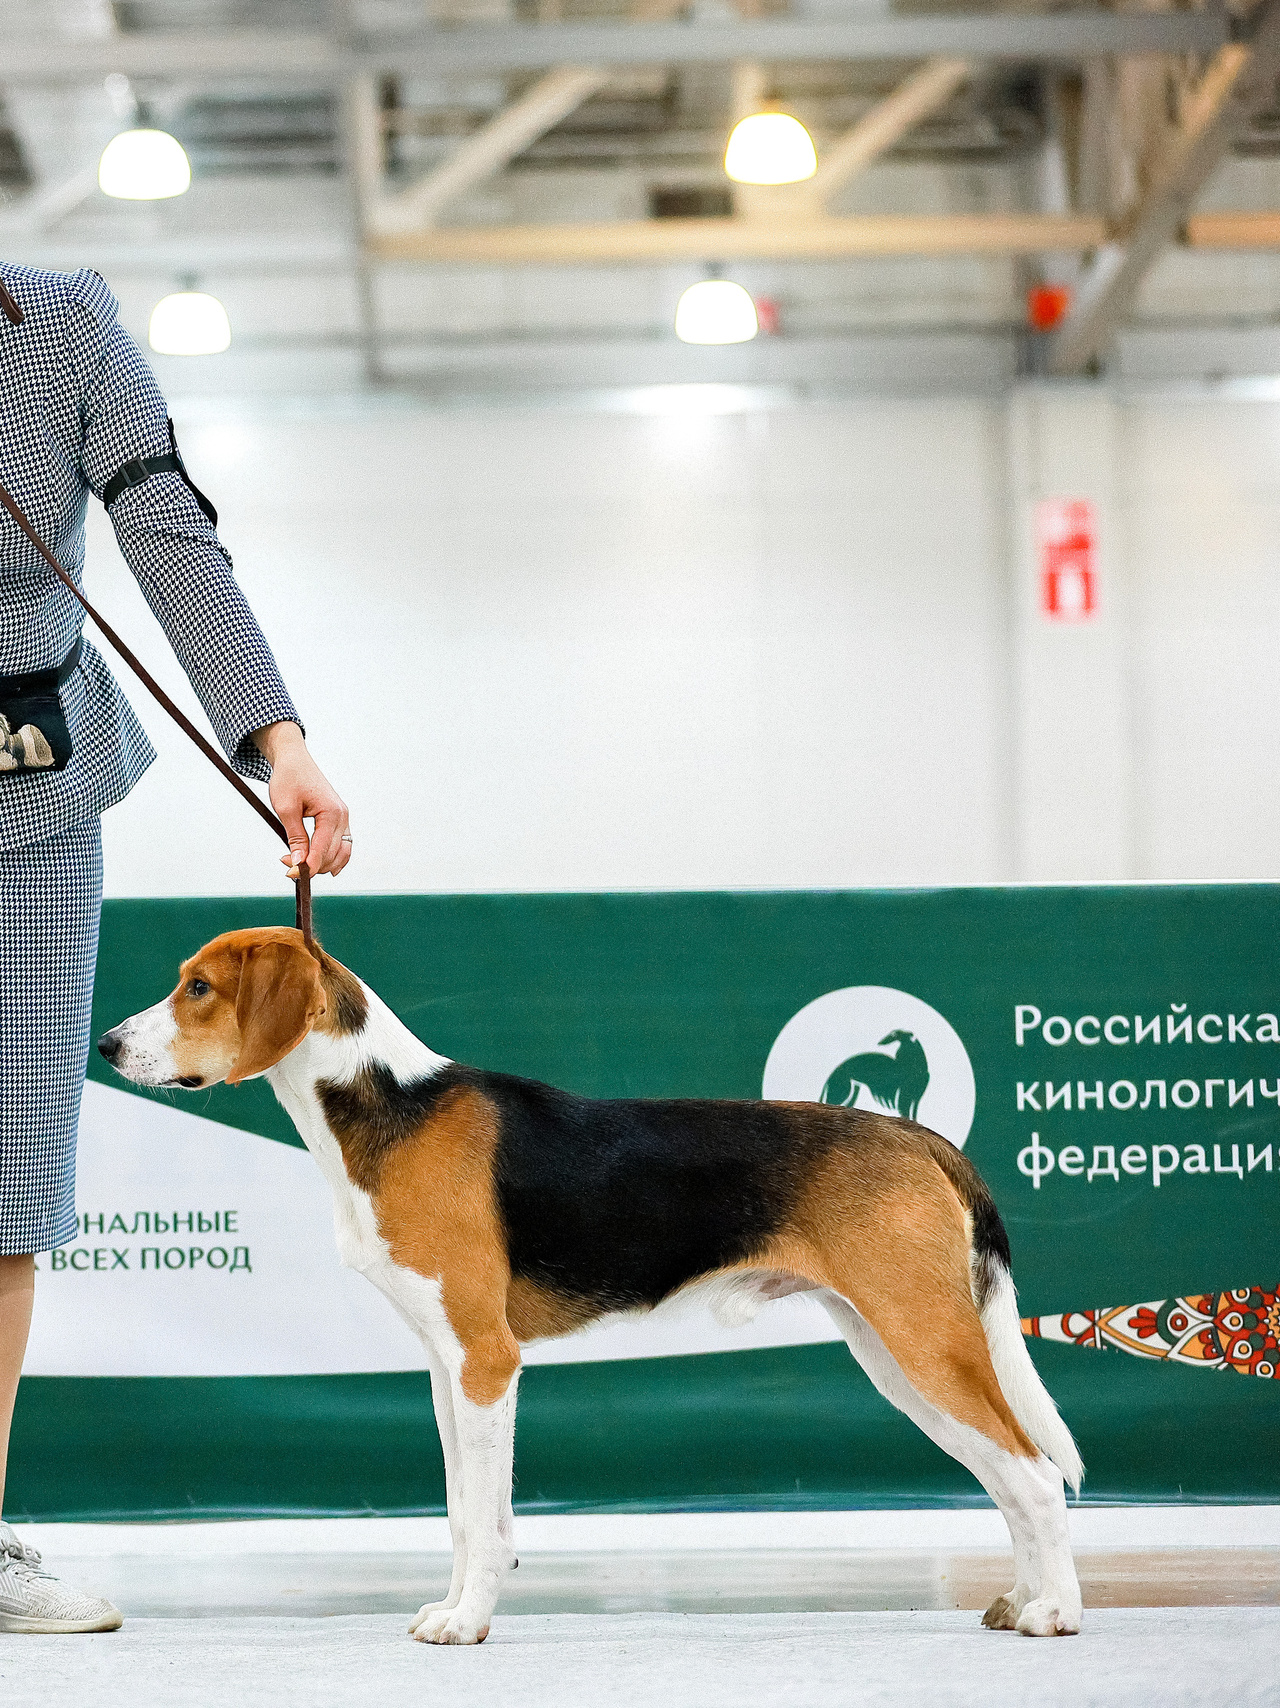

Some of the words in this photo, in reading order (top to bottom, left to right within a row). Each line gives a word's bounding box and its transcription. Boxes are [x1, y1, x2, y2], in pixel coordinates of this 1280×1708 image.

[1014, 1003, 1280, 1047] Российска
[1016, 1131, 1280, 1190] федераци
[77, 1209, 239, 1235] НАЛЬНЫЕ
[51, 1247, 131, 1272] ВСЕХ
[140, 1245, 253, 1274] ПОРОД
